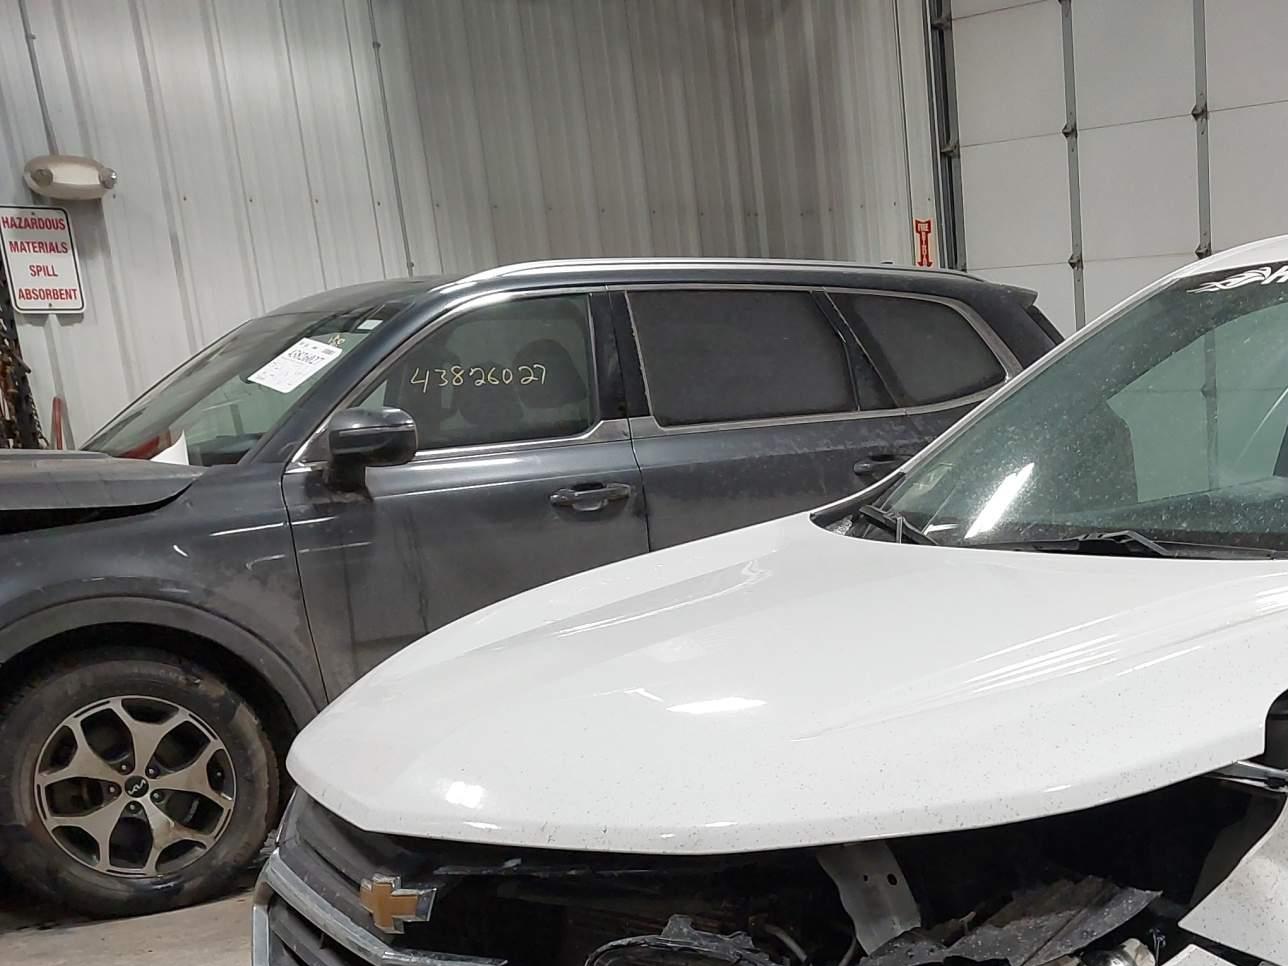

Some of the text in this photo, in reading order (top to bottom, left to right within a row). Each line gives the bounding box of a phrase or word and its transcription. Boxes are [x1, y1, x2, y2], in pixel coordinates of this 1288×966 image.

[1, 216, 66, 231] HAZARDOUS
[9, 241, 68, 254] MATERIALS
[29, 264, 58, 277] SPILL
[18, 288, 77, 301] ABSORBENT
